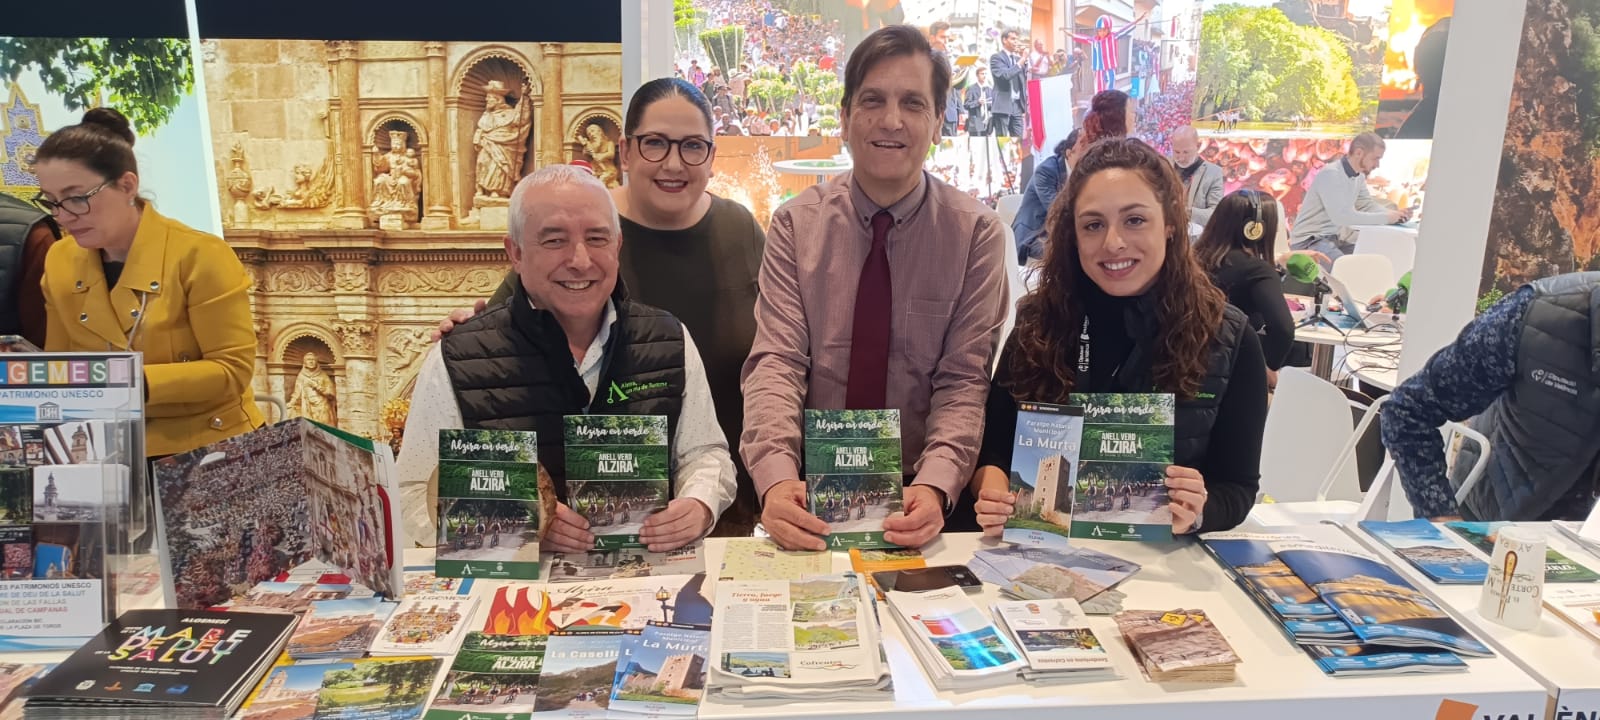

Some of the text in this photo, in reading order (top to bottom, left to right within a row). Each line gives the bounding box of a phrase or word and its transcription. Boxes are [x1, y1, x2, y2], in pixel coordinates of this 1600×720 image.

[0, 390, 104, 399] ATRIMONIO UNESCO
[1114, 405, 1126, 414] en
[576, 424, 608, 439] Alzira
[609, 427, 622, 436] en
[816, 419, 844, 432] Alzira
[846, 420, 858, 430] en
[450, 439, 480, 454] Alzira
[482, 443, 494, 452] en
[1018, 434, 1076, 450] La Murta
[1100, 440, 1136, 454] ALZIRA
[836, 446, 867, 454] ANELL VERD
[598, 460, 634, 473] ALZIRA
[835, 454, 868, 467] ALZIRA
[472, 470, 489, 478] ANELL
[470, 477, 506, 491] ALZIRA
[480, 638, 516, 648] Alzira
[642, 640, 660, 648] La
[492, 661, 536, 670] ALZIRA
